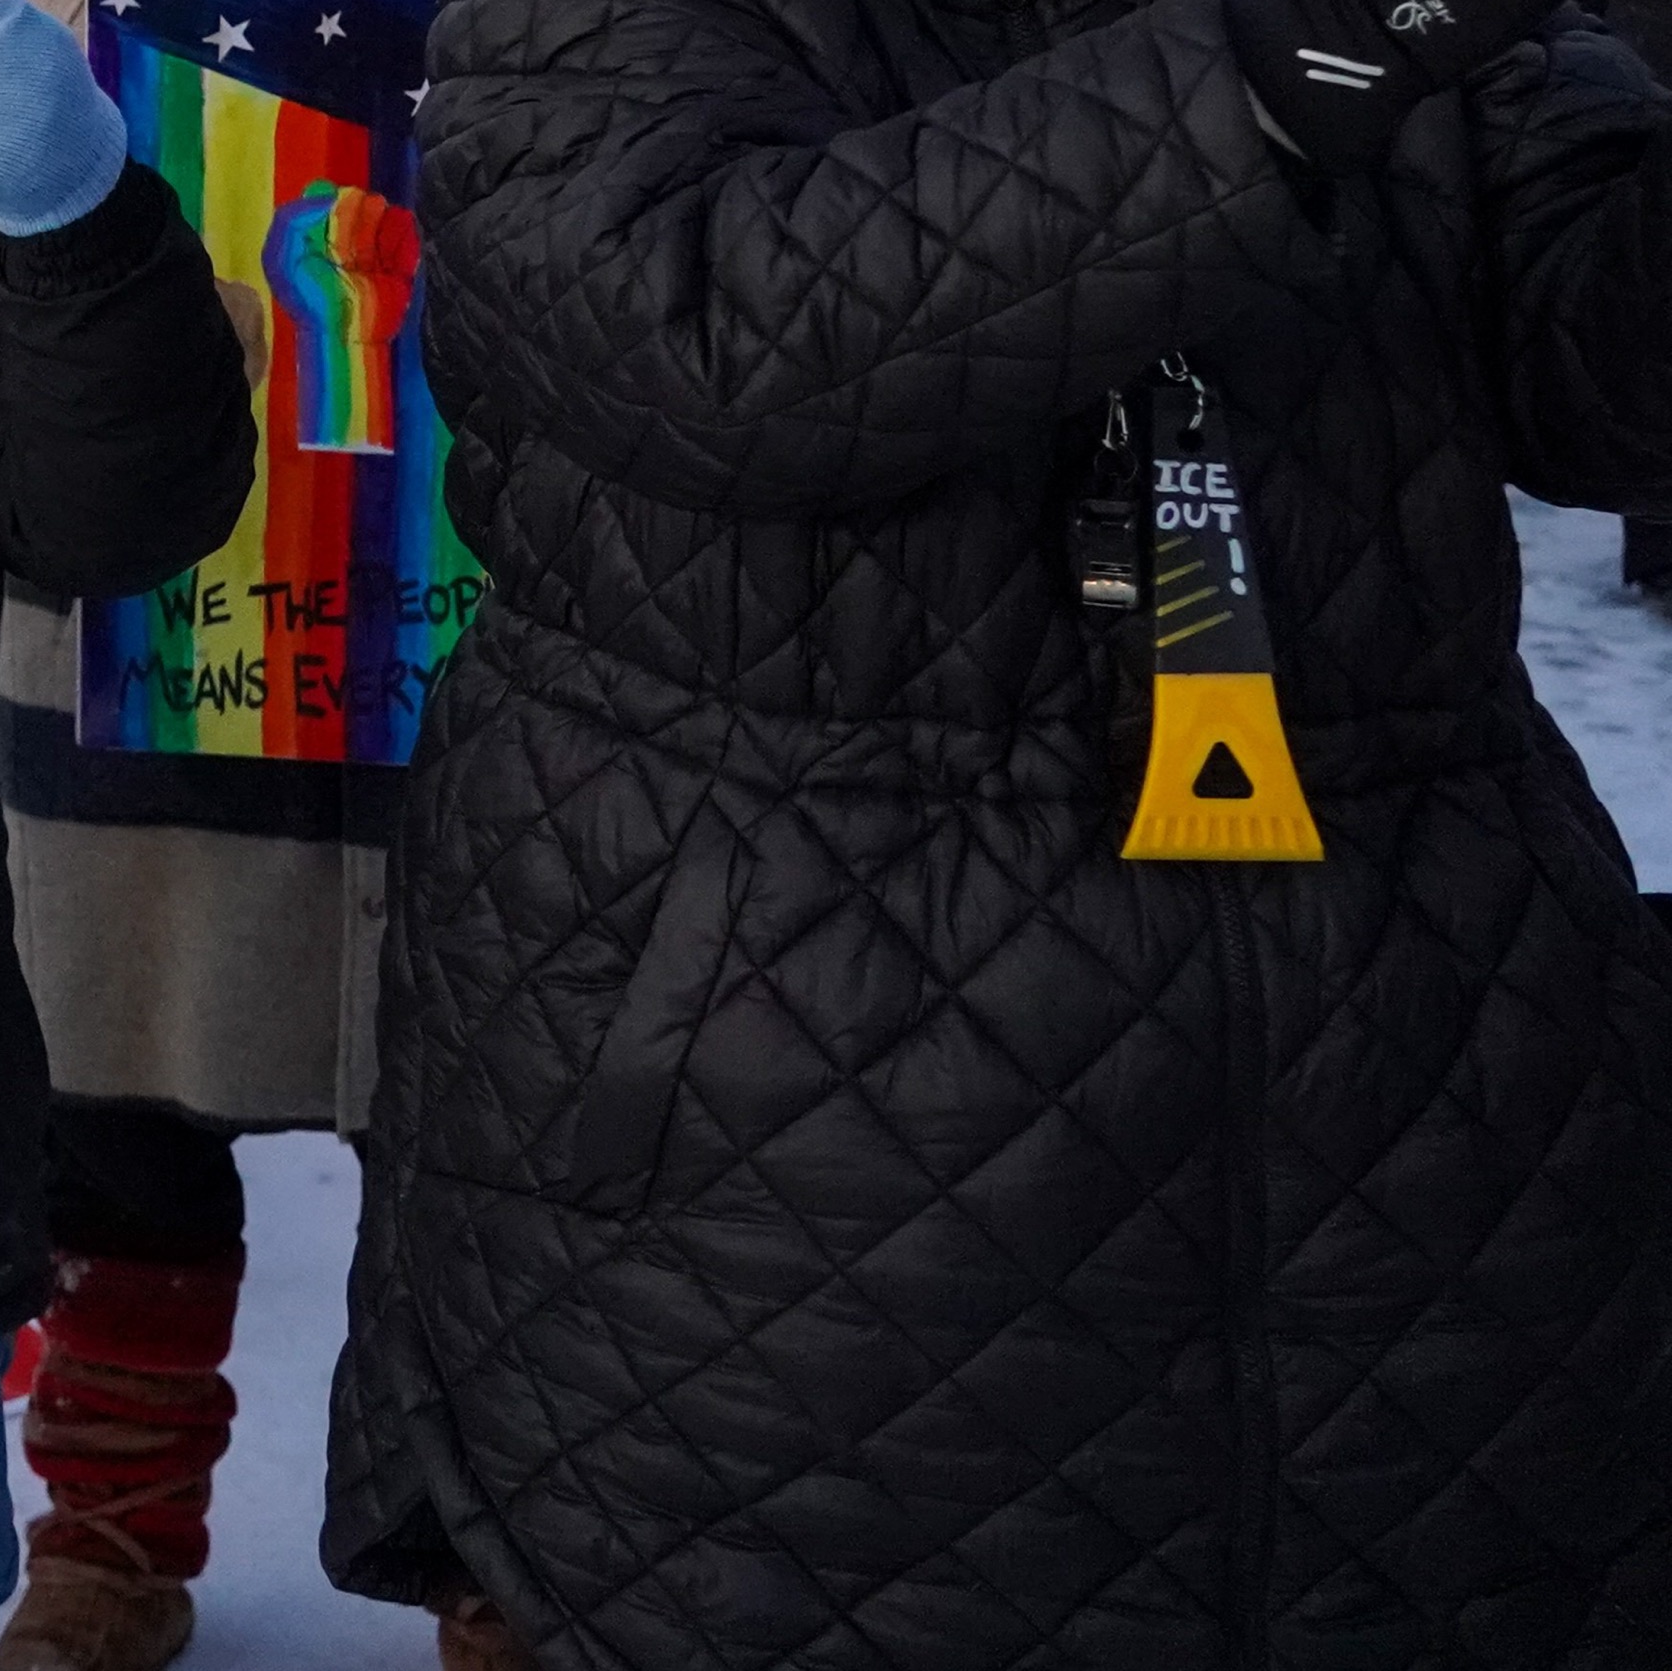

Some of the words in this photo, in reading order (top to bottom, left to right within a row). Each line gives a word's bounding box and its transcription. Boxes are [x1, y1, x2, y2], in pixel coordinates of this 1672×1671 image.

[1153, 459, 1235, 499] ICE
[1156, 501, 1240, 533] OUT
[157, 565, 232, 634] WE
[246, 579, 348, 634] THE
[119, 648, 270, 717] MEANS
